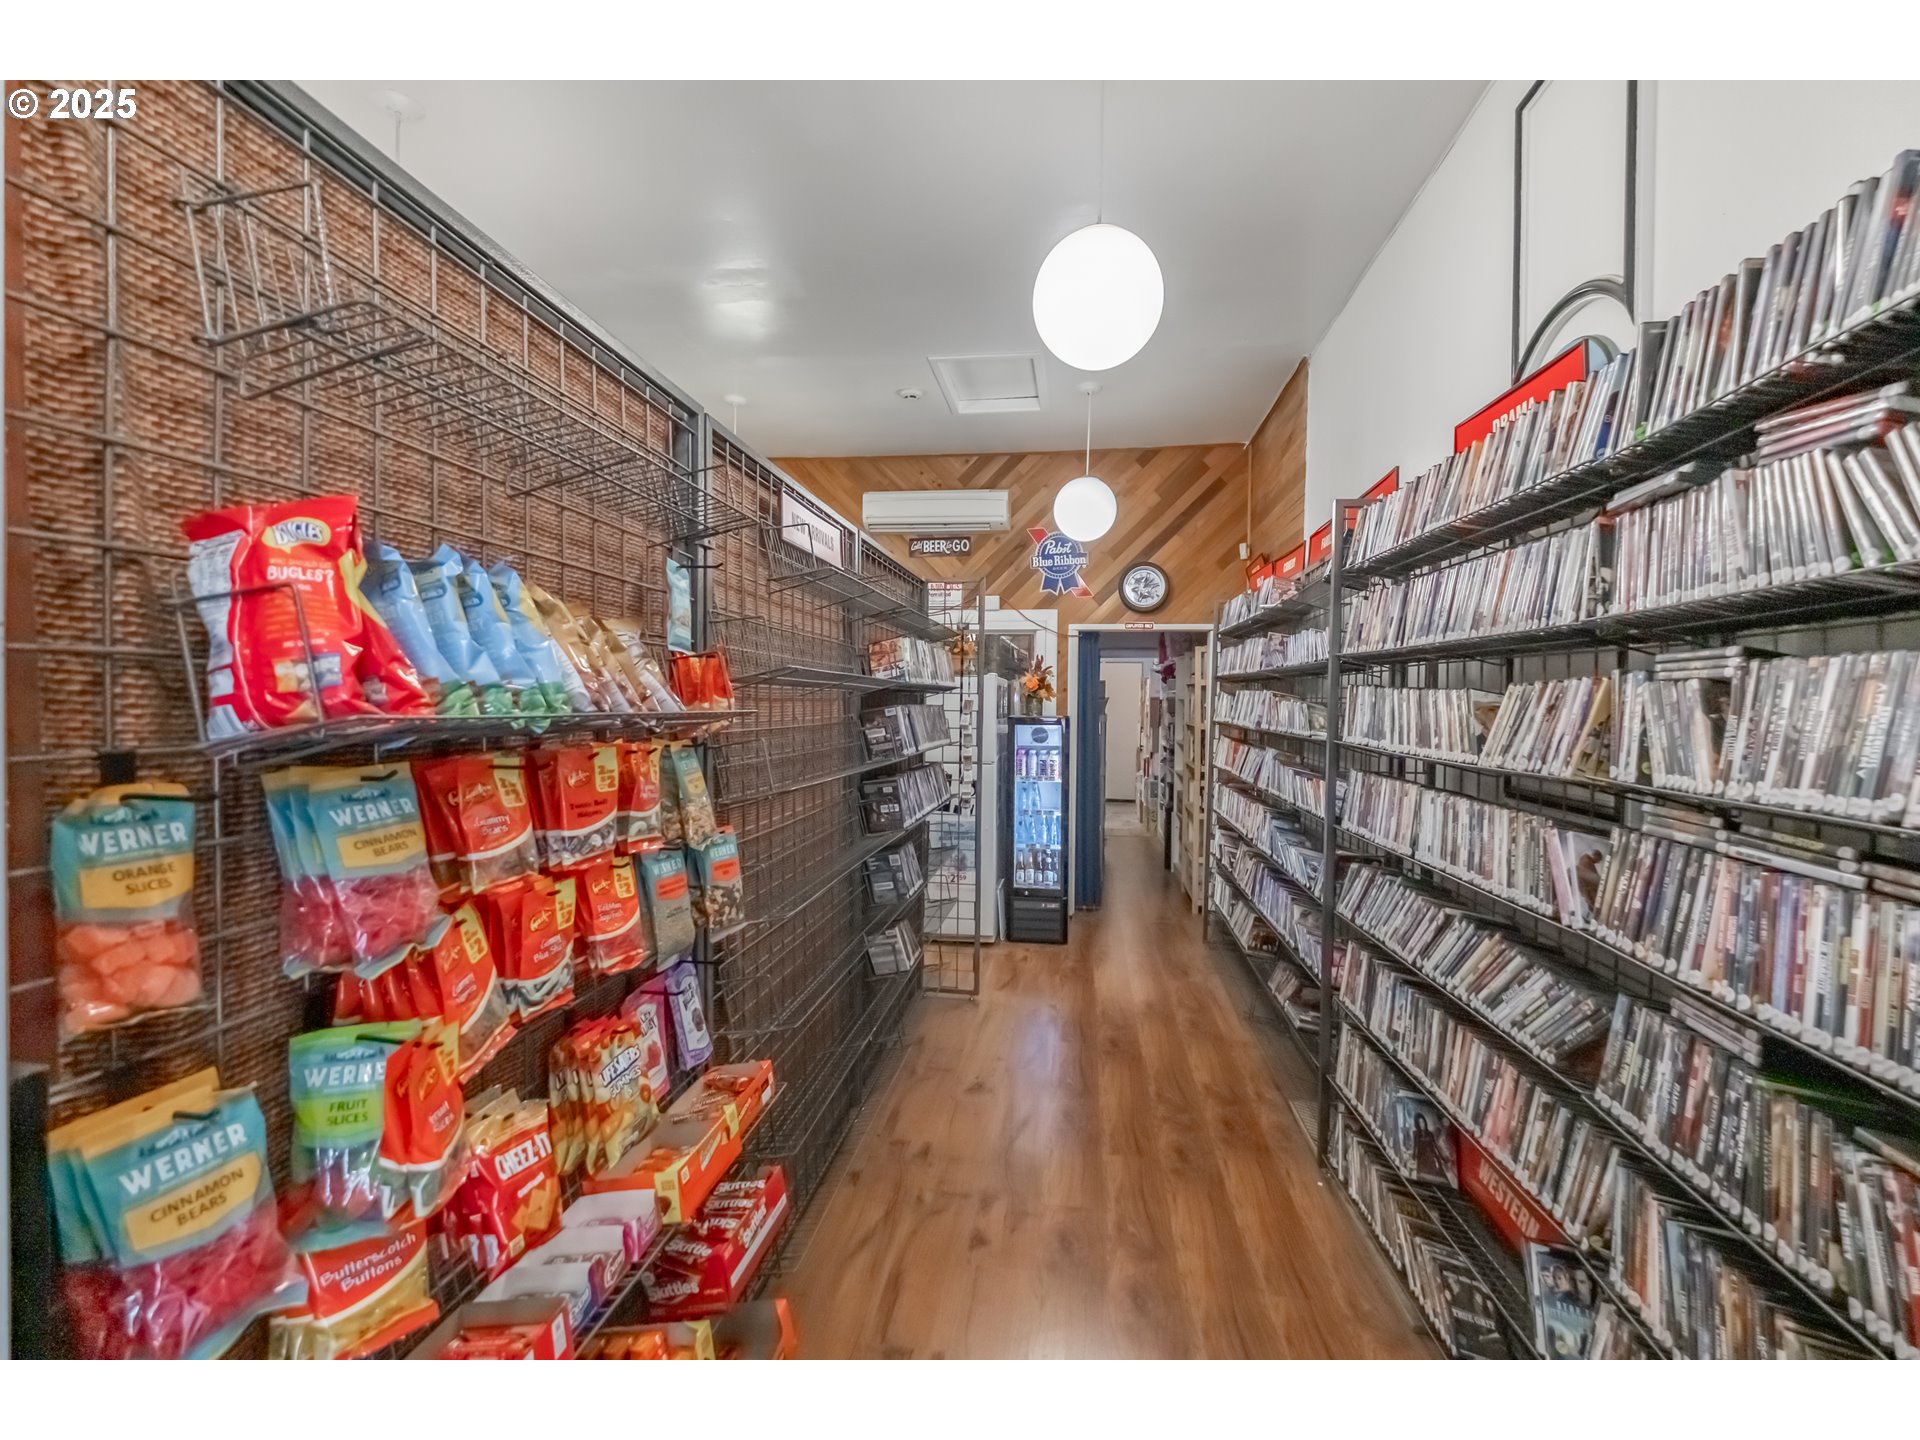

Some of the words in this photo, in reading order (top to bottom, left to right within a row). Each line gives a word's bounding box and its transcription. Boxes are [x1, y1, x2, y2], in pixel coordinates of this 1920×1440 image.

[792, 512, 806, 535] NEW
[808, 523, 834, 551] RRIVALS
[923, 540, 948, 553] BEER
[953, 539, 970, 552] GO
[1045, 540, 1072, 554] Pabst
[1033, 556, 1053, 568] Blue
[1054, 555, 1087, 567] Ribbon
[266, 565, 335, 583] BUGLES?
[328, 796, 415, 828] WERNER
[78, 820, 189, 855] WERNER
[353, 828, 418, 851] CINNAMON
[373, 840, 409, 857] BEARS
[112, 861, 176, 882] ORANGE
[125, 877, 173, 896] SLICES
[304, 1062, 387, 1088] WERNE
[328, 1097, 368, 1114] FRUIT
[325, 1110, 369, 1127] SLICES
[119, 1122, 248, 1196] WERNER
[494, 1131, 552, 1181] CHEEZ-IT
[150, 1168, 244, 1224] CINNAMON
[1478, 1161, 1540, 1238] WESTERN
[176, 1192, 228, 1228] BEARS
[319, 1231, 417, 1286] Butterscotch
[664, 1240, 713, 1257] Skittle
[339, 1254, 403, 1293] Buttons
[647, 1281, 699, 1301] Skittles
[1452, 1308, 1473, 1324] TRUE
